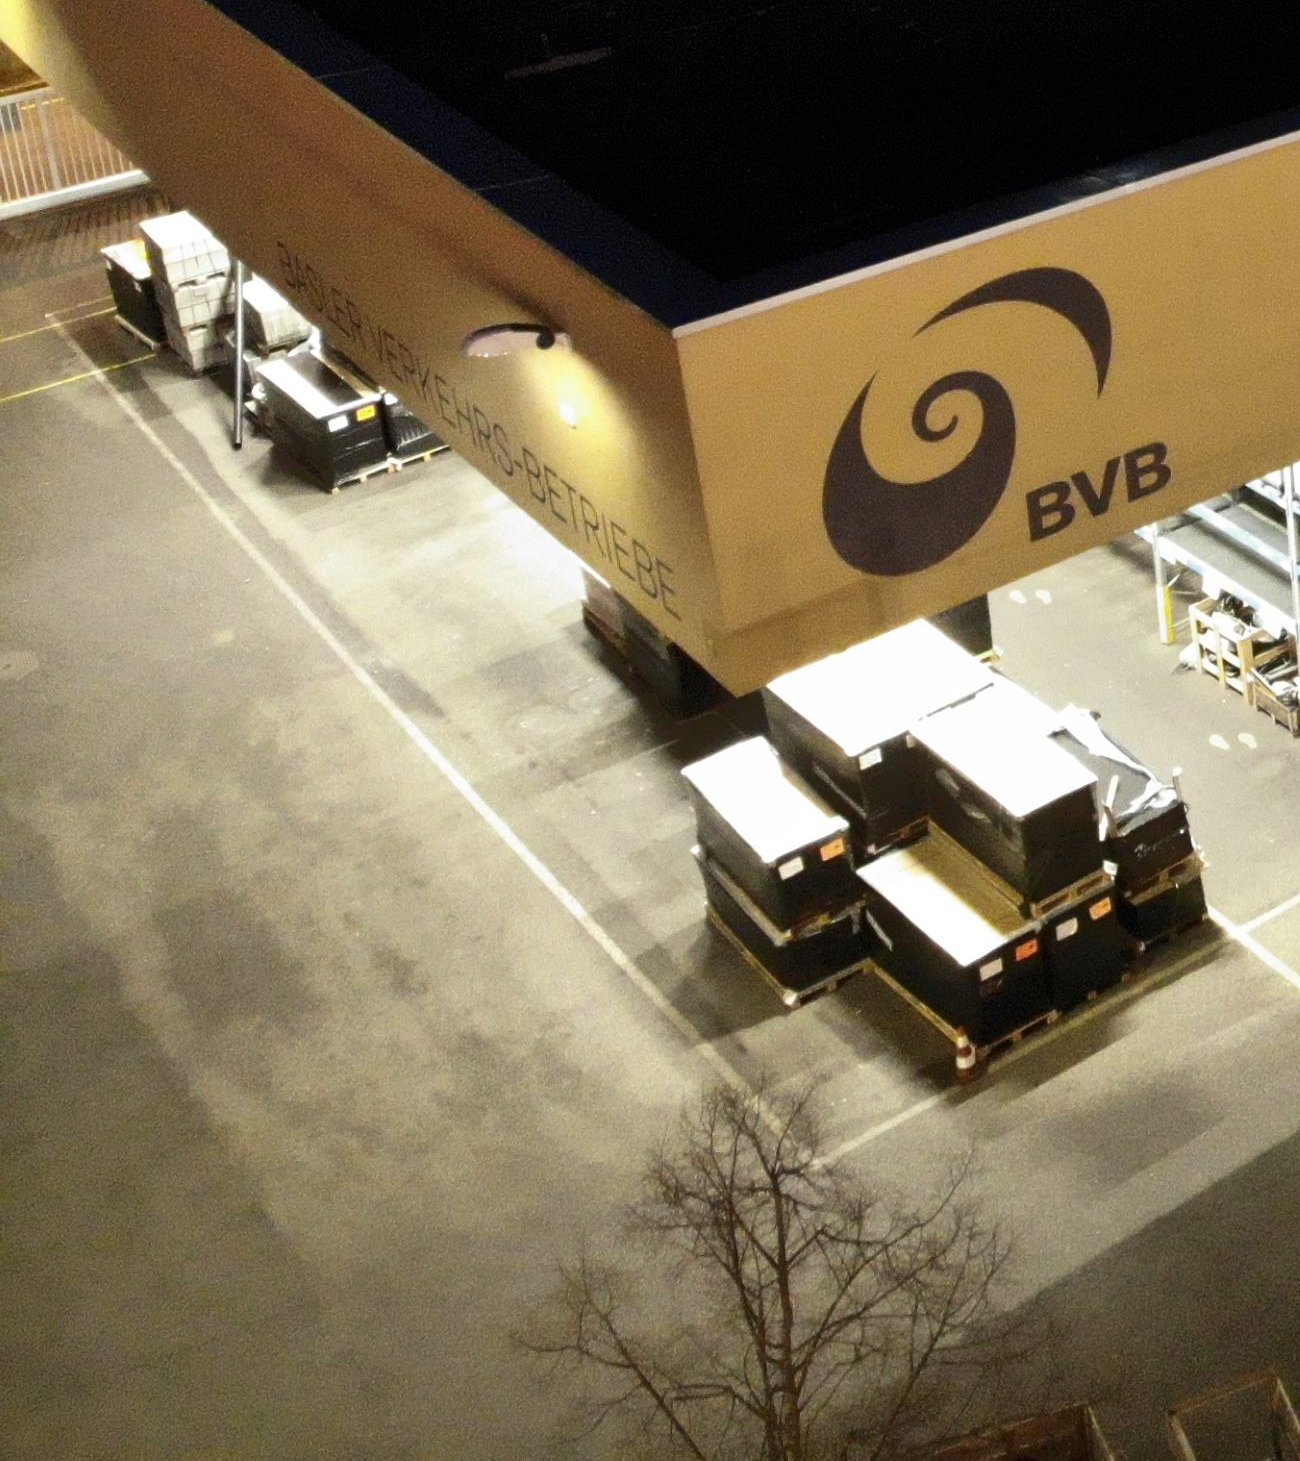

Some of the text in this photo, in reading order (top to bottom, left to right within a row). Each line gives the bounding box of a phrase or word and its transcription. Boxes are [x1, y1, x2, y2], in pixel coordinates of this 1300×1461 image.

[276, 240, 682, 622] BASLER VERKEHRS-BETRIEBE
[1025, 441, 1172, 543] BVB
